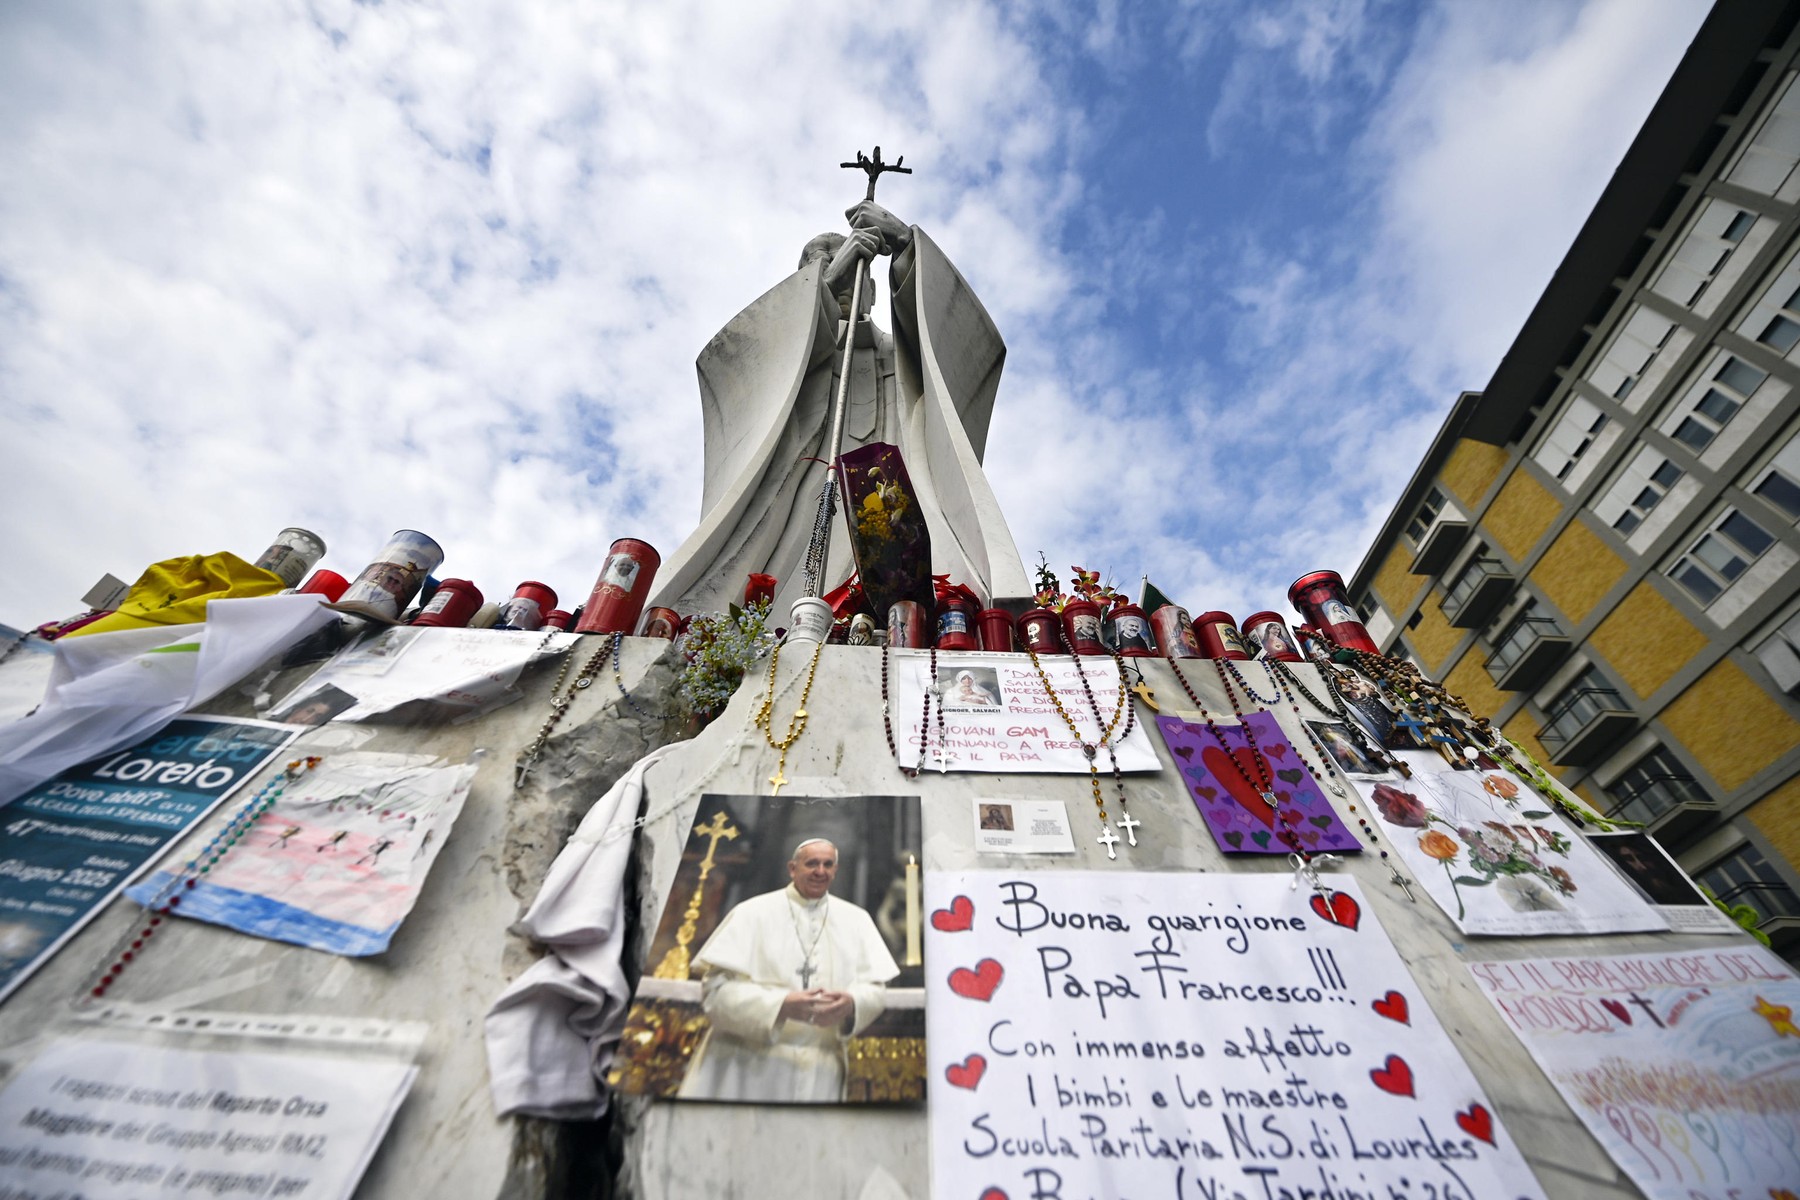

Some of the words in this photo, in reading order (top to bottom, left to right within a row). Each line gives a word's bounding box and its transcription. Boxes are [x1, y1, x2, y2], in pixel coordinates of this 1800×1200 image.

[1063, 669, 1109, 678] CHESA
[1003, 687, 1118, 696] INCESSNTEMNTE
[1010, 696, 1020, 704] A
[1008, 706, 1084, 714] PREGHIRA
[929, 726, 995, 735] GIOVANI
[1006, 726, 1050, 738] GAM
[932, 750, 962, 760] PR
[970, 753, 983, 761] IL
[1000, 752, 1042, 761] PAPA
[1020, 741, 1031, 750] A
[94, 752, 234, 788] Loreto
[114, 807, 183, 826] SPERANZA
[60, 868, 117, 888] 2025
[996, 882, 1130, 937] Buona
[1148, 904, 1307, 954] guarigione
[1551, 960, 1615, 990] PAPA
[1714, 953, 1793, 982] DEL
[1037, 946, 1141, 1020] Papa
[989, 1020, 1056, 1057] Con
[1074, 1030, 1206, 1059] immenso
[1223, 1024, 1352, 1073] affetto
[1027, 1074, 1037, 1108] I
[1055, 1074, 1132, 1108] bimbi
[1152, 1093, 1168, 1110] e
[1175, 1073, 1214, 1110] le
[1222, 1077, 1349, 1111] maestre
[208, 1091, 281, 1117] Reparto
[282, 1095, 328, 1118] Orsa
[964, 1113, 1080, 1160] Scuola
[1080, 1114, 1224, 1160] Paritaria
[1340, 1115, 1479, 1161] Lourdes
